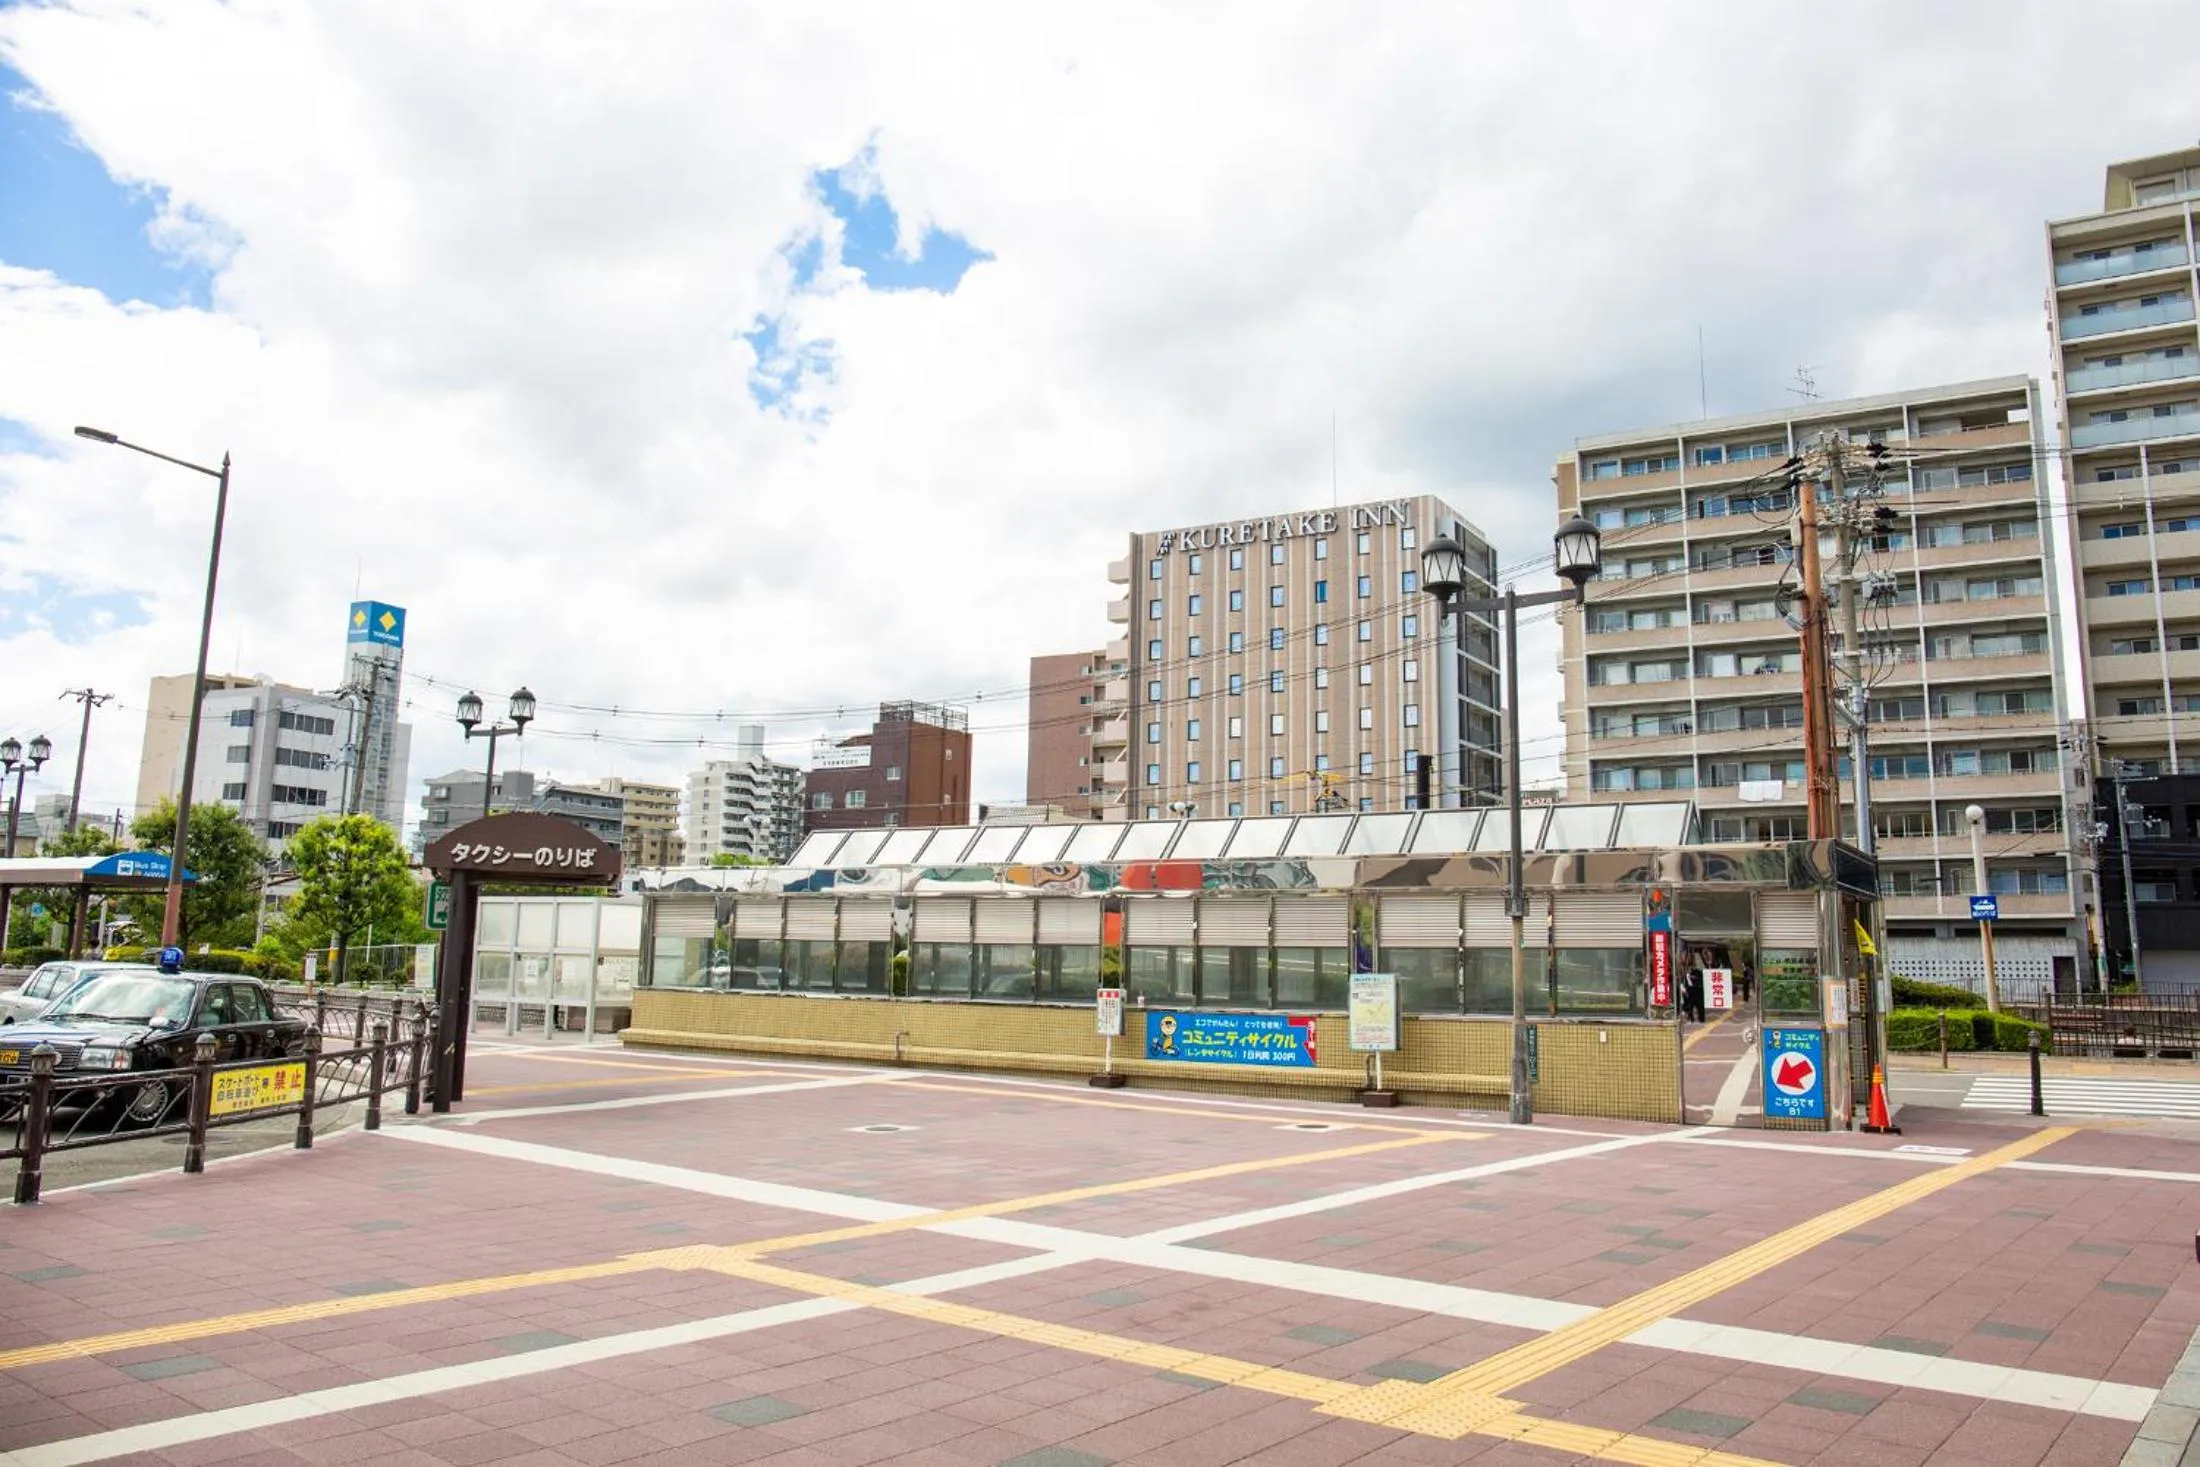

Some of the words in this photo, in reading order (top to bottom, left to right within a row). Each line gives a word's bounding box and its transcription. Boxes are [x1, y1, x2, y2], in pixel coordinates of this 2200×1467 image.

[1178, 511, 1339, 552] KURETAKE
[1351, 499, 1410, 530] INN
[451, 843, 598, 868] タクシーのりば
[1711, 971, 1724, 1007] 非常口
[1182, 1030, 1298, 1048] コミュニティサイクル
[1784, 1033, 1820, 1041] コミュニティ
[1785, 1042, 1812, 1050] サイクル
[1272, 1051, 1296, 1061] 300円
[273, 1067, 302, 1090] 禁止
[1774, 1097, 1815, 1108] こちらです
